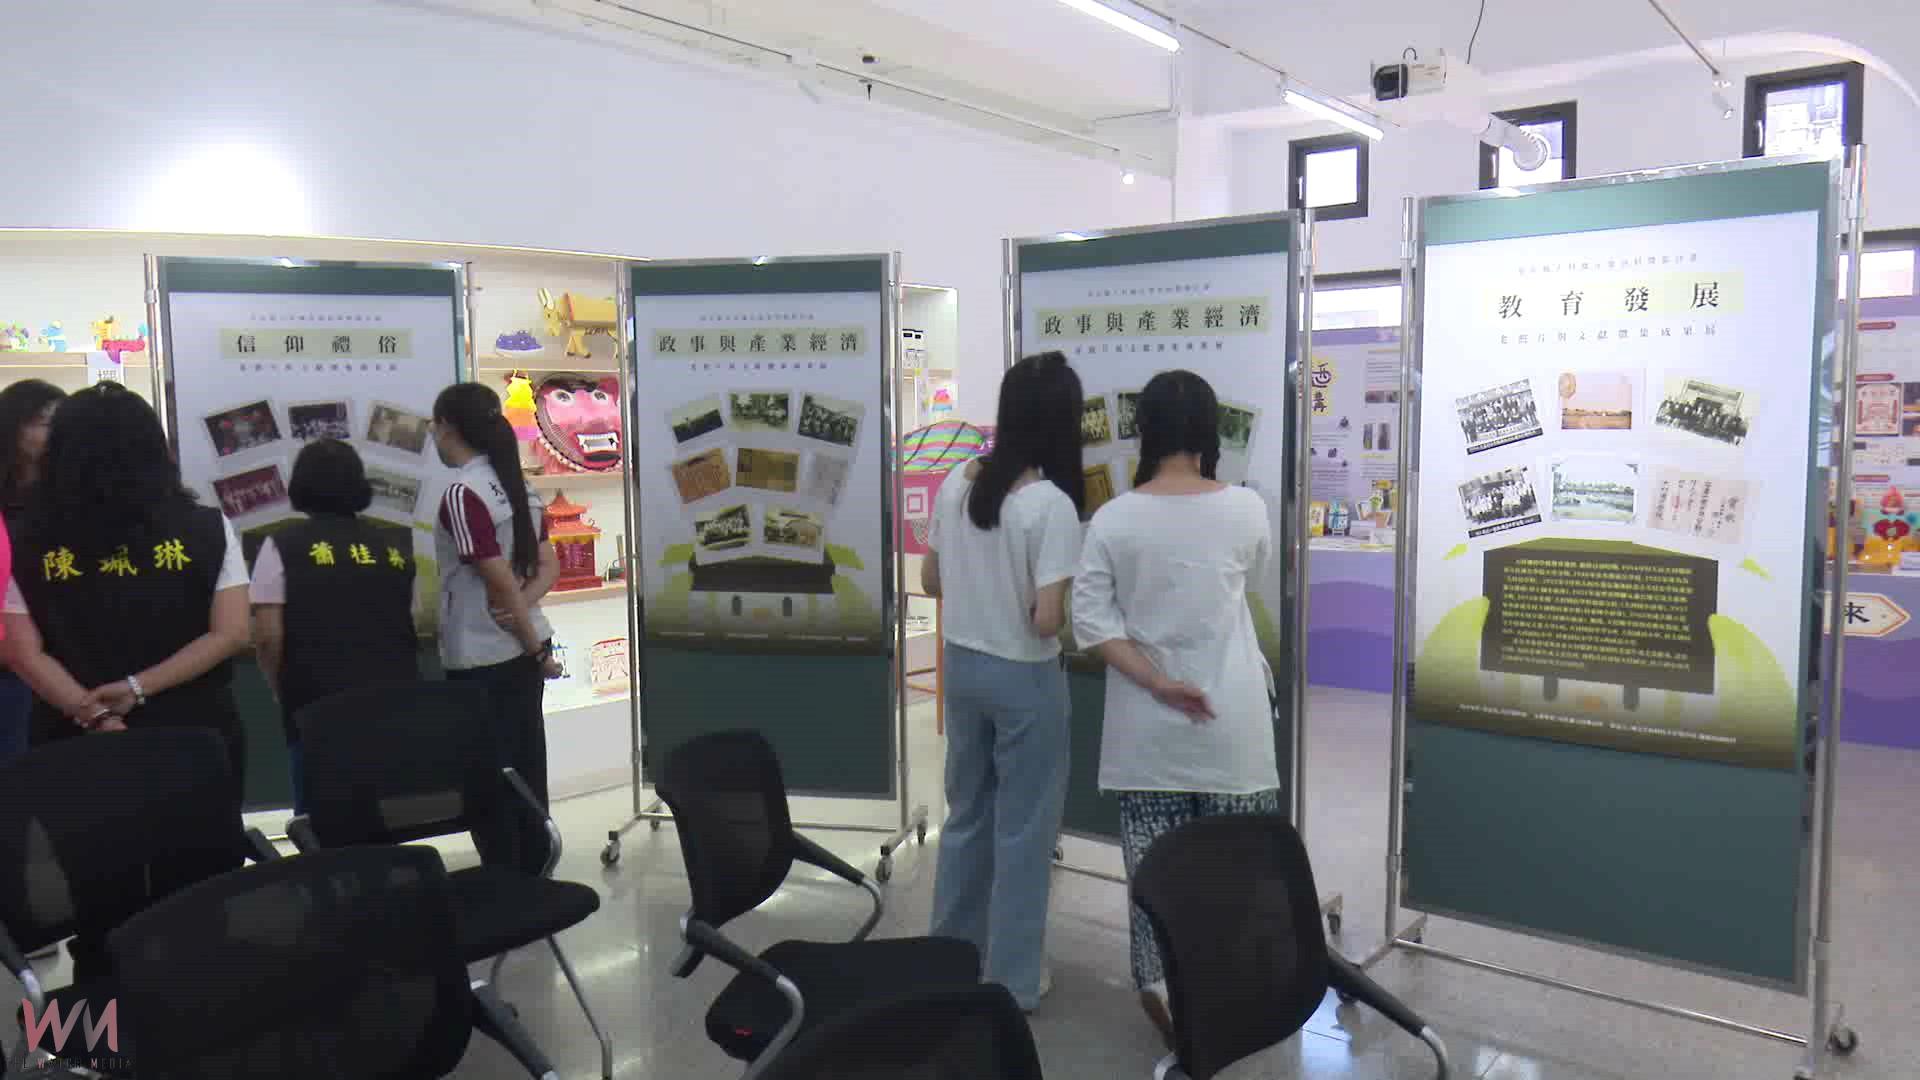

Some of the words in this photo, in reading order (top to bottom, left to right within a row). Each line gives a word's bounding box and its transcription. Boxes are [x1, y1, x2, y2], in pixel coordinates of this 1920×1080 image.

[1498, 281, 1720, 319] 教育發展
[1044, 304, 1261, 335] 政事與產業經濟
[236, 335, 397, 354] 信仰禮俗
[659, 333, 858, 353] 政事與產業經濟
[42, 537, 193, 581] 陳珮琳
